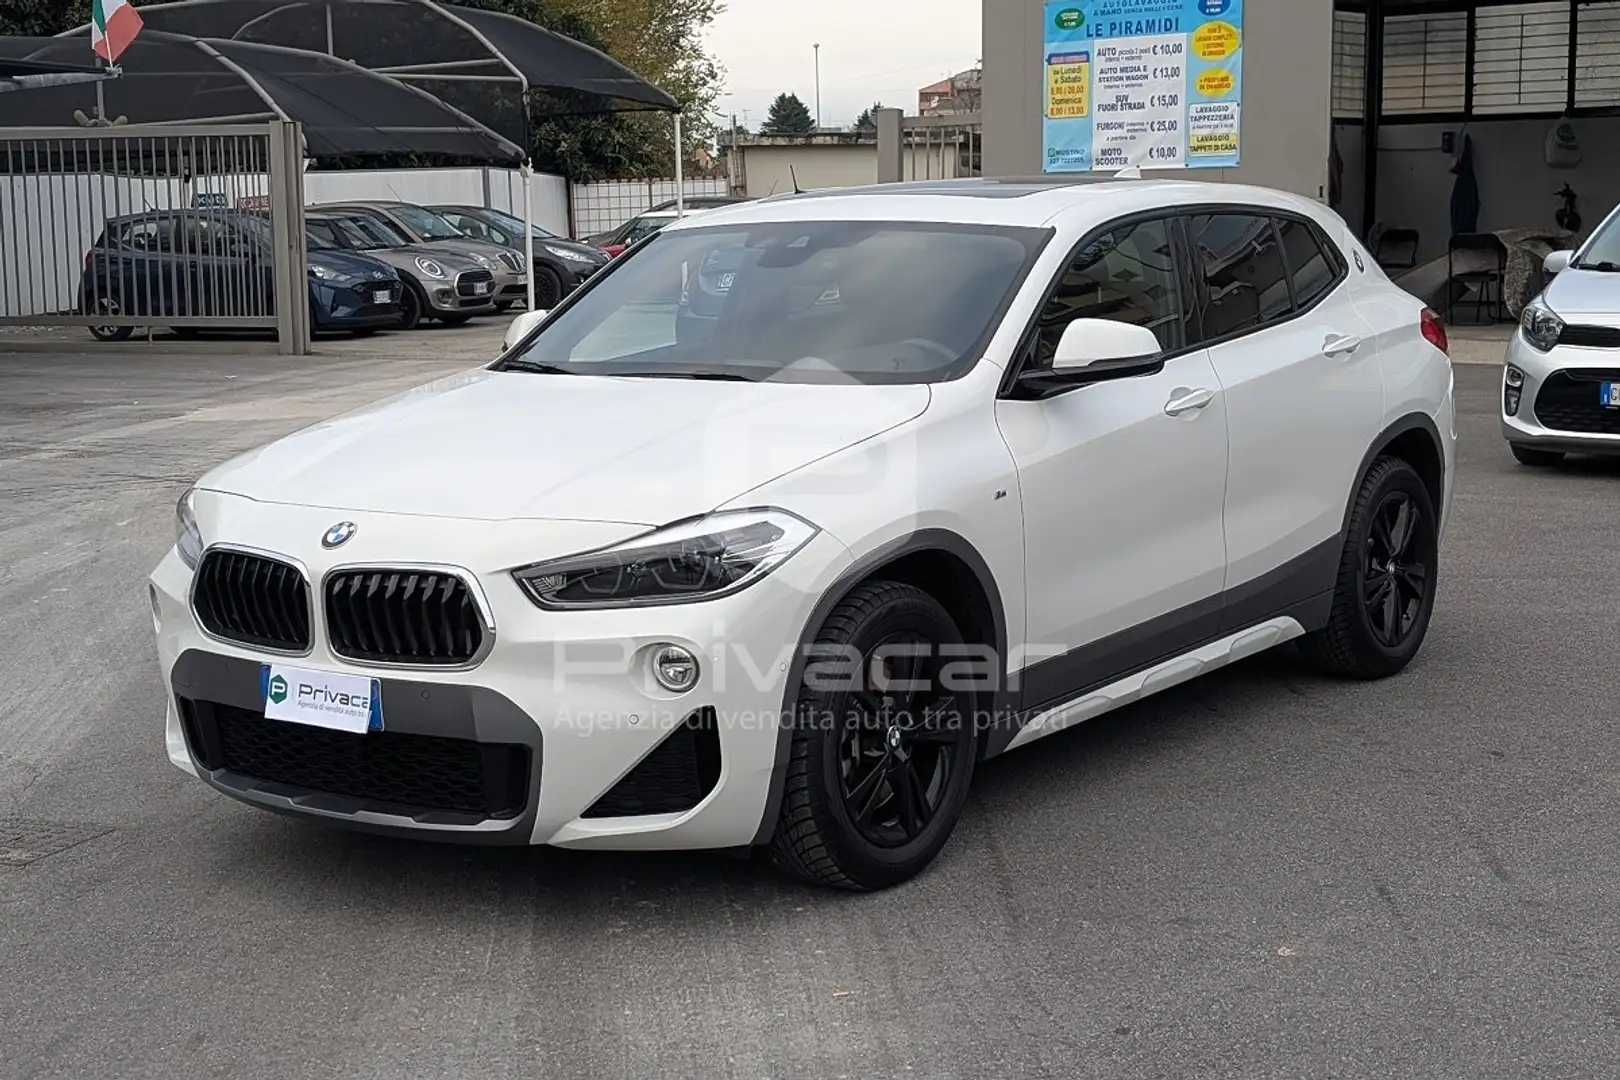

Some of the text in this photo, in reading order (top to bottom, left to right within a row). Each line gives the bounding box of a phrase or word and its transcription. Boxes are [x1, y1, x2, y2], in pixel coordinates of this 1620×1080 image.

[1086, 23, 1103, 38] LE
[1109, 17, 1179, 36] PIRAMIDI
[1096, 47, 1116, 57] AUTO
[1152, 44, 1158, 56] €
[1160, 43, 1182, 56] 10,00
[1099, 67, 1118, 75] AUTO
[1120, 66, 1142, 74] MEDIA
[1152, 66, 1180, 80] € 13,00
[1098, 75, 1124, 83] STATION
[1052, 97, 1082, 105] Domenica
[1115, 94, 1130, 102] SUV
[1150, 94, 1178, 108] € 15,00
[1098, 102, 1146, 112] FUORI STRADA
[1195, 105, 1230, 114] LAVAGGIO
[1190, 113, 1235, 122] TAPPEZZERIA
[1150, 120, 1156, 132] €
[1156, 120, 1178, 133] 25,00
[1196, 134, 1230, 142] LAVAGGIO
[1100, 146, 1177, 160] MOTO € 10,00
[1094, 156, 1128, 165] SCOOTER
